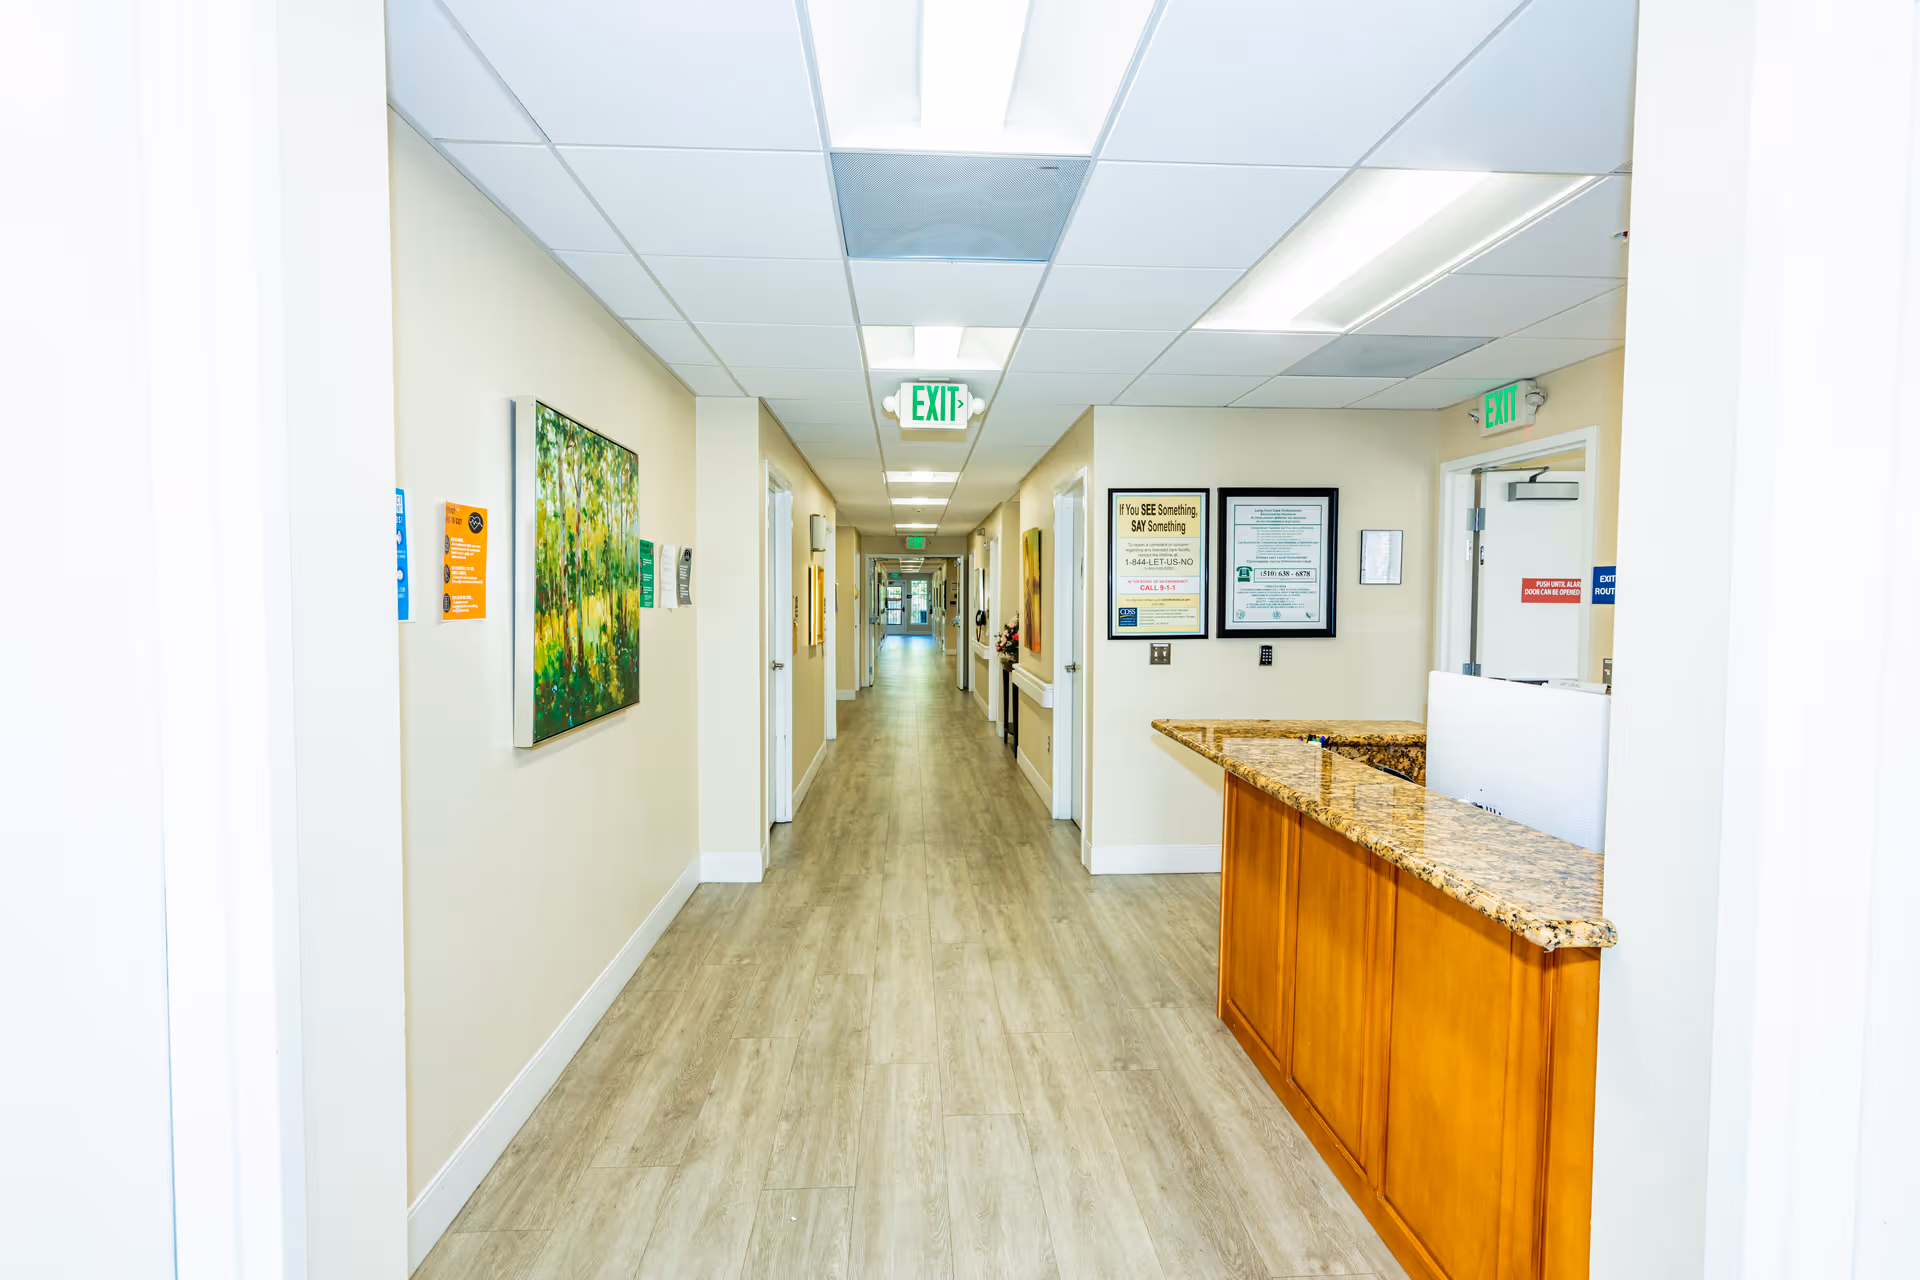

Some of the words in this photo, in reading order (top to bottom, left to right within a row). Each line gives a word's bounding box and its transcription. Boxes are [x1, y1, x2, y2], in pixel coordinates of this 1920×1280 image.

[912, 385, 960, 422] EXIT
[1485, 384, 1518, 428] EXIT
[1120, 504, 1124, 516] If
[1126, 504, 1140, 516] You
[1141, 504, 1156, 516] SEE
[1158, 504, 1198, 518] Something,
[1131, 520, 1146, 532] SAY
[1148, 520, 1186, 535] Something
[909, 536, 924, 548] EXIT
